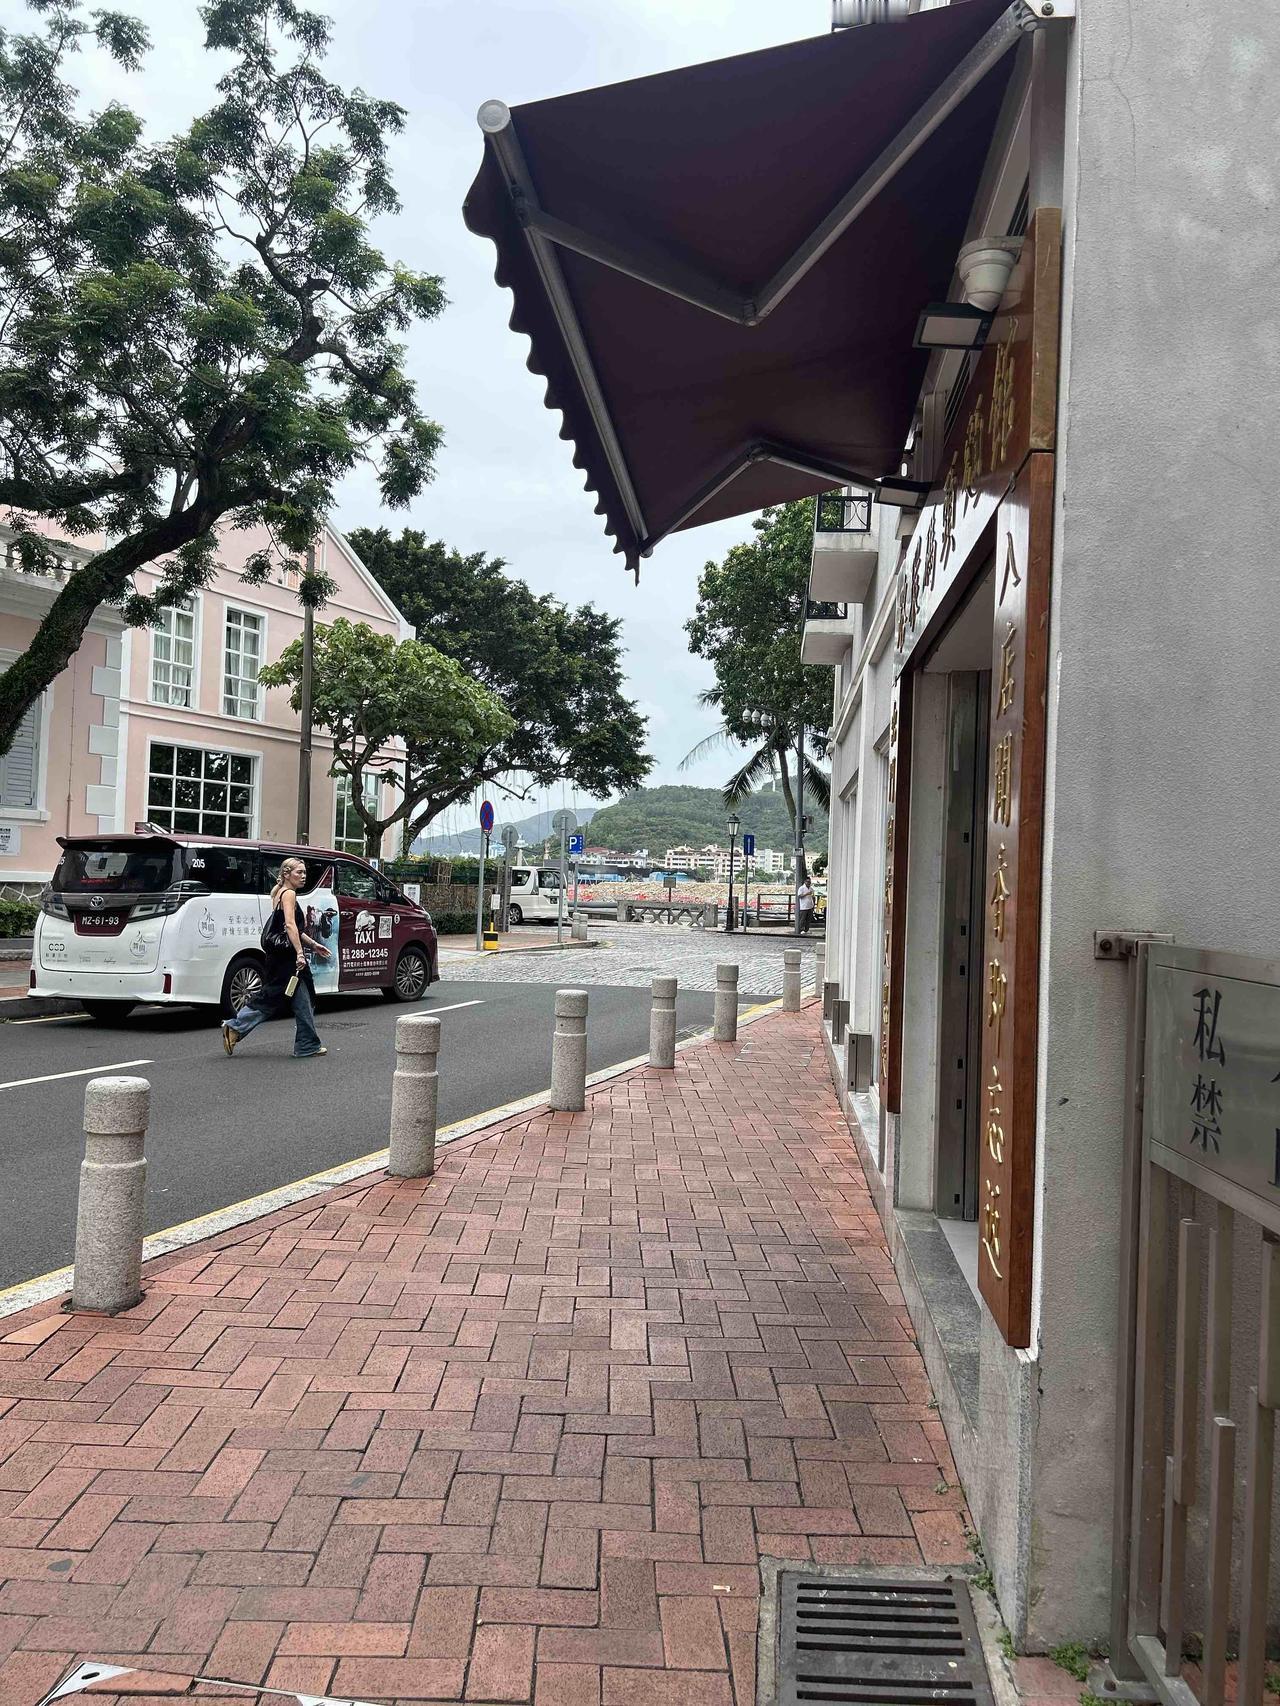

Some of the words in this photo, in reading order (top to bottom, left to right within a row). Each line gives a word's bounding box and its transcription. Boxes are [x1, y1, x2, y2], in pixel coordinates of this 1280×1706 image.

[569, 836, 578, 850] P
[191, 858, 206, 869] 205
[81, 916, 120, 926] MZ-61-93
[354, 930, 376, 945] TAXI
[350, 948, 389, 959] 288-12345
